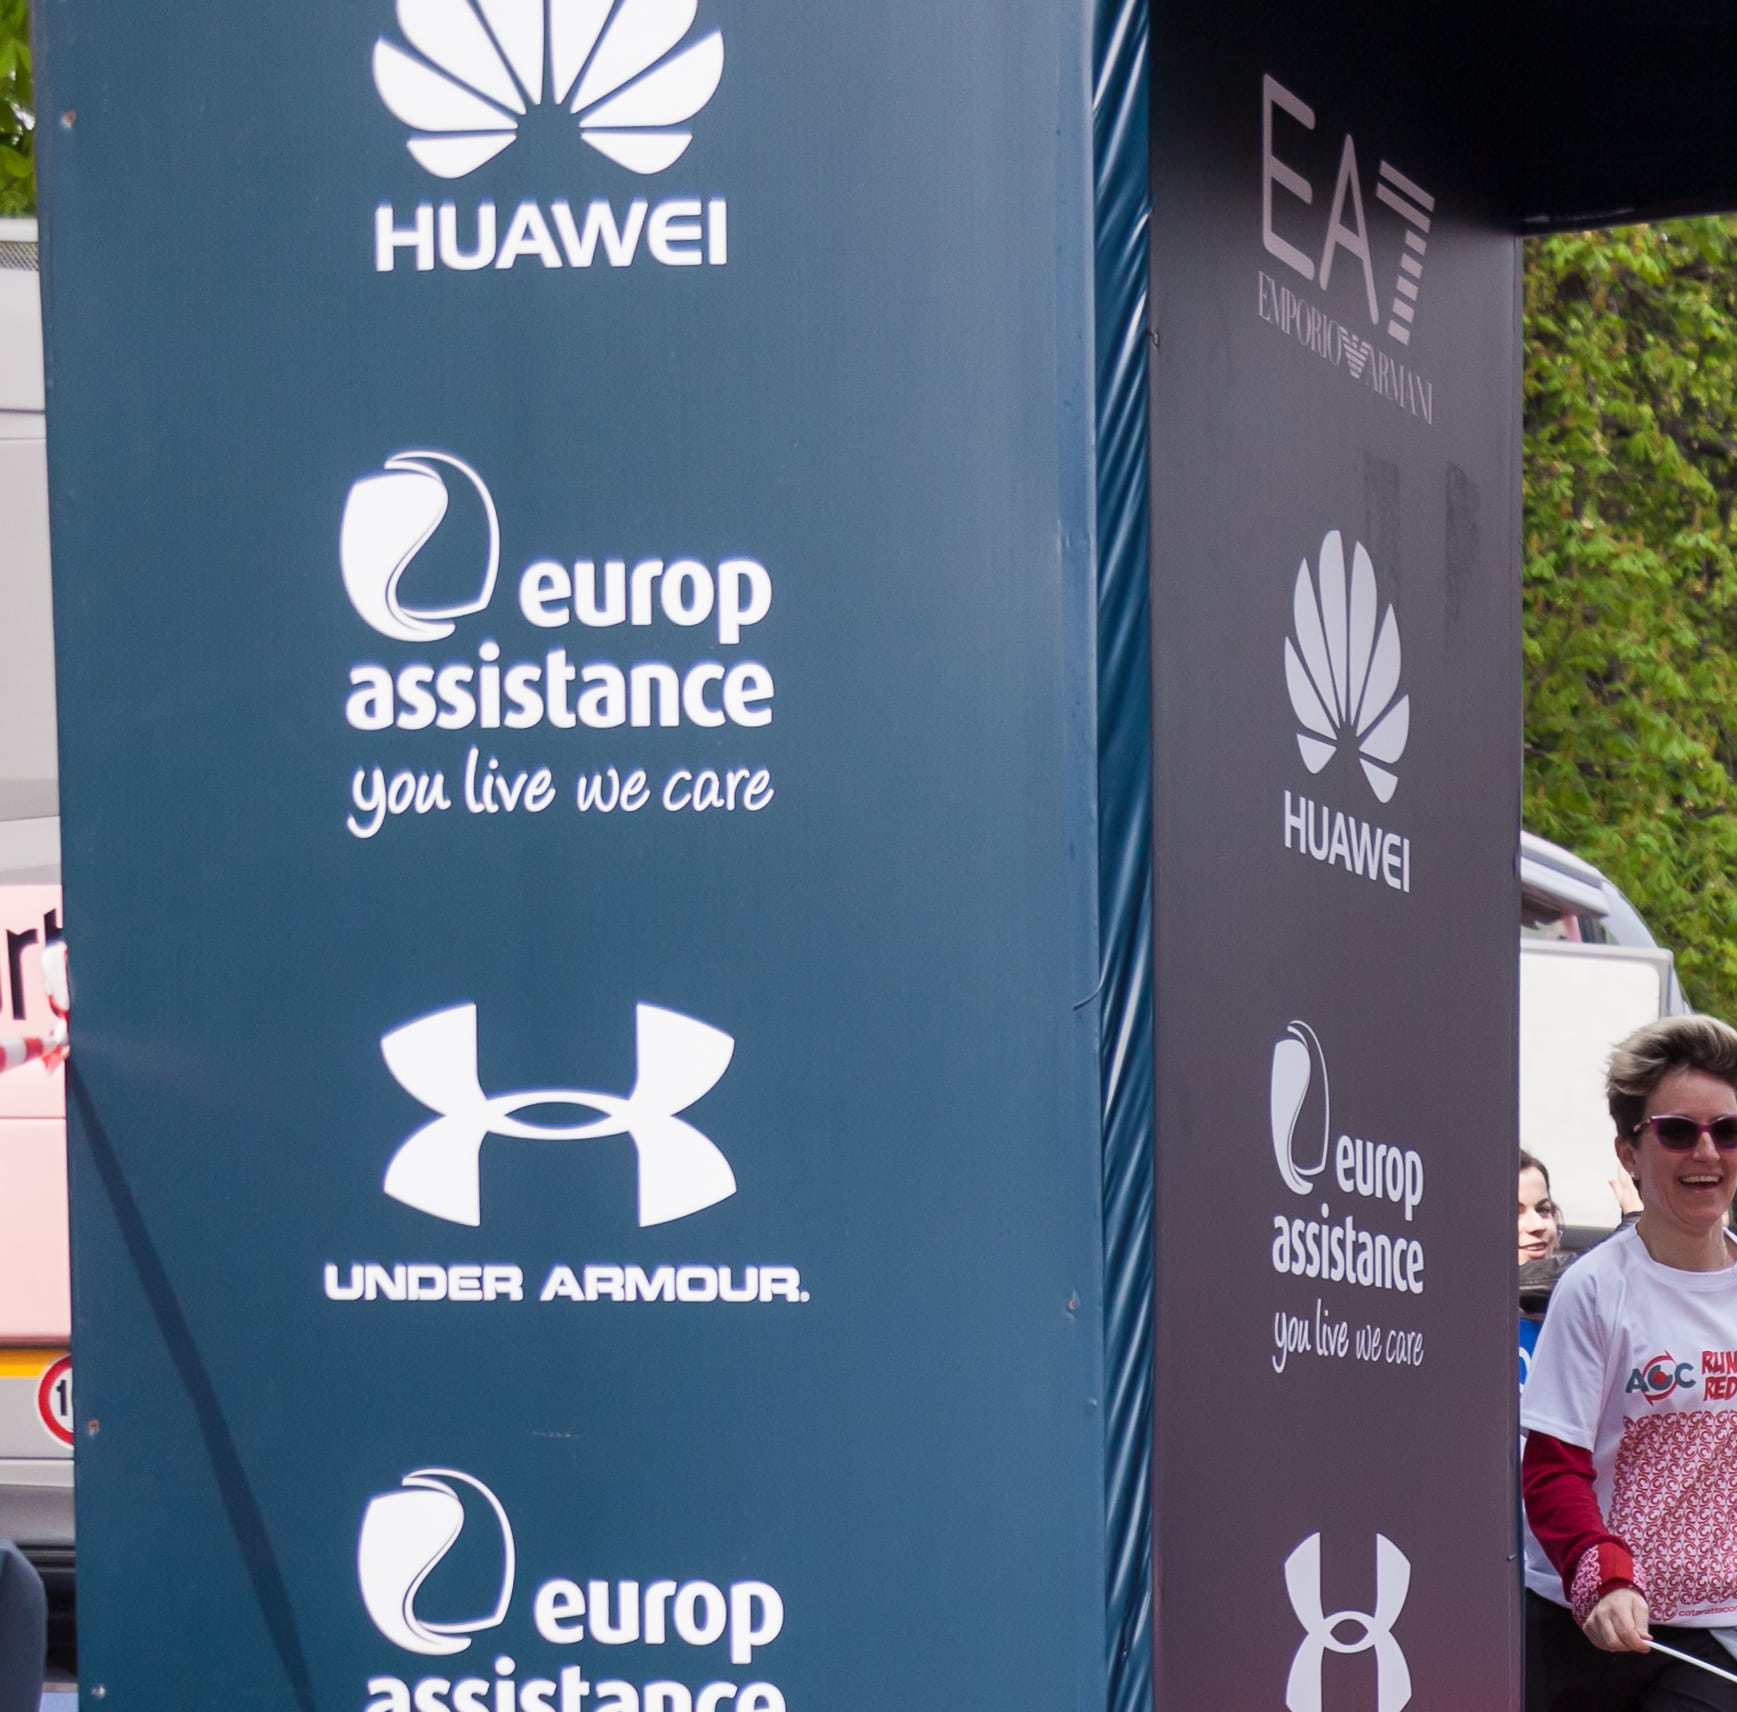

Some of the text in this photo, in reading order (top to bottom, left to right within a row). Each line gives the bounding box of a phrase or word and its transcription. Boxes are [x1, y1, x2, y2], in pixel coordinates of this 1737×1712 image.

[375, 199, 727, 271] HUAWEI
[1258, 270, 1433, 425] EMPORIO ARMANI
[519, 559, 772, 644] europ
[345, 641, 774, 730] assistance
[347, 747, 774, 838] you live we care
[1284, 790, 1410, 893] HUAWEI
[1336, 1135, 1424, 1221] europ
[324, 1263, 523, 1302] UNDER
[1272, 1203, 1424, 1294] assistance
[1272, 1298, 1424, 1373] you live we care
[535, 1580, 785, 1664] europ
